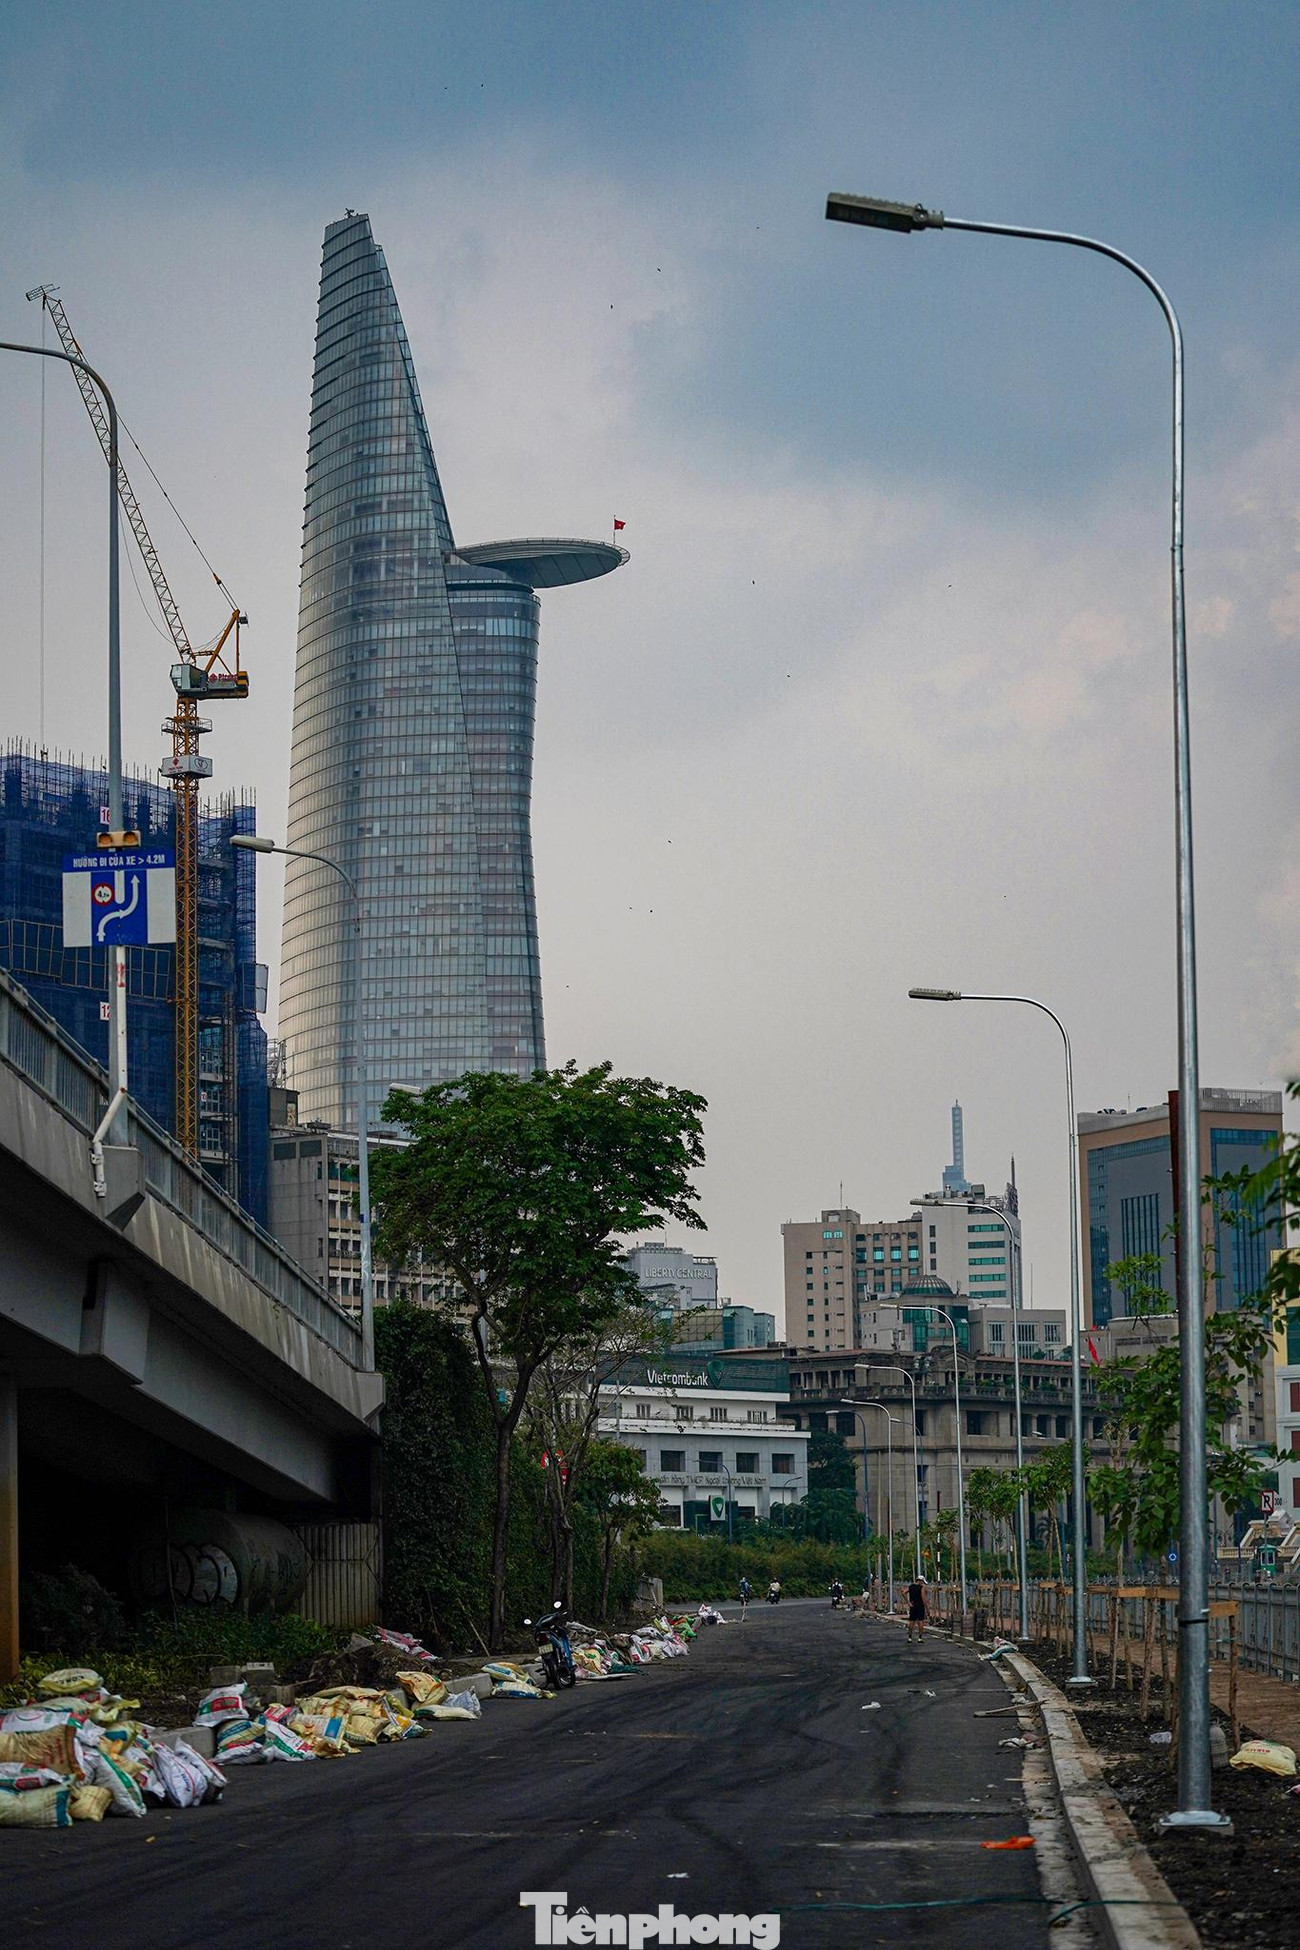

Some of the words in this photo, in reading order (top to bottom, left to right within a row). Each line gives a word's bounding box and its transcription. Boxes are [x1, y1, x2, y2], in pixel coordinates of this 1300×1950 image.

[109, 853, 124, 866] CỦA
[126, 855, 136, 865] XE
[146, 854, 165, 864] 4.2M
[645, 1267, 675, 1279] LIBERTY
[676, 1268, 712, 1280] CENTRAL
